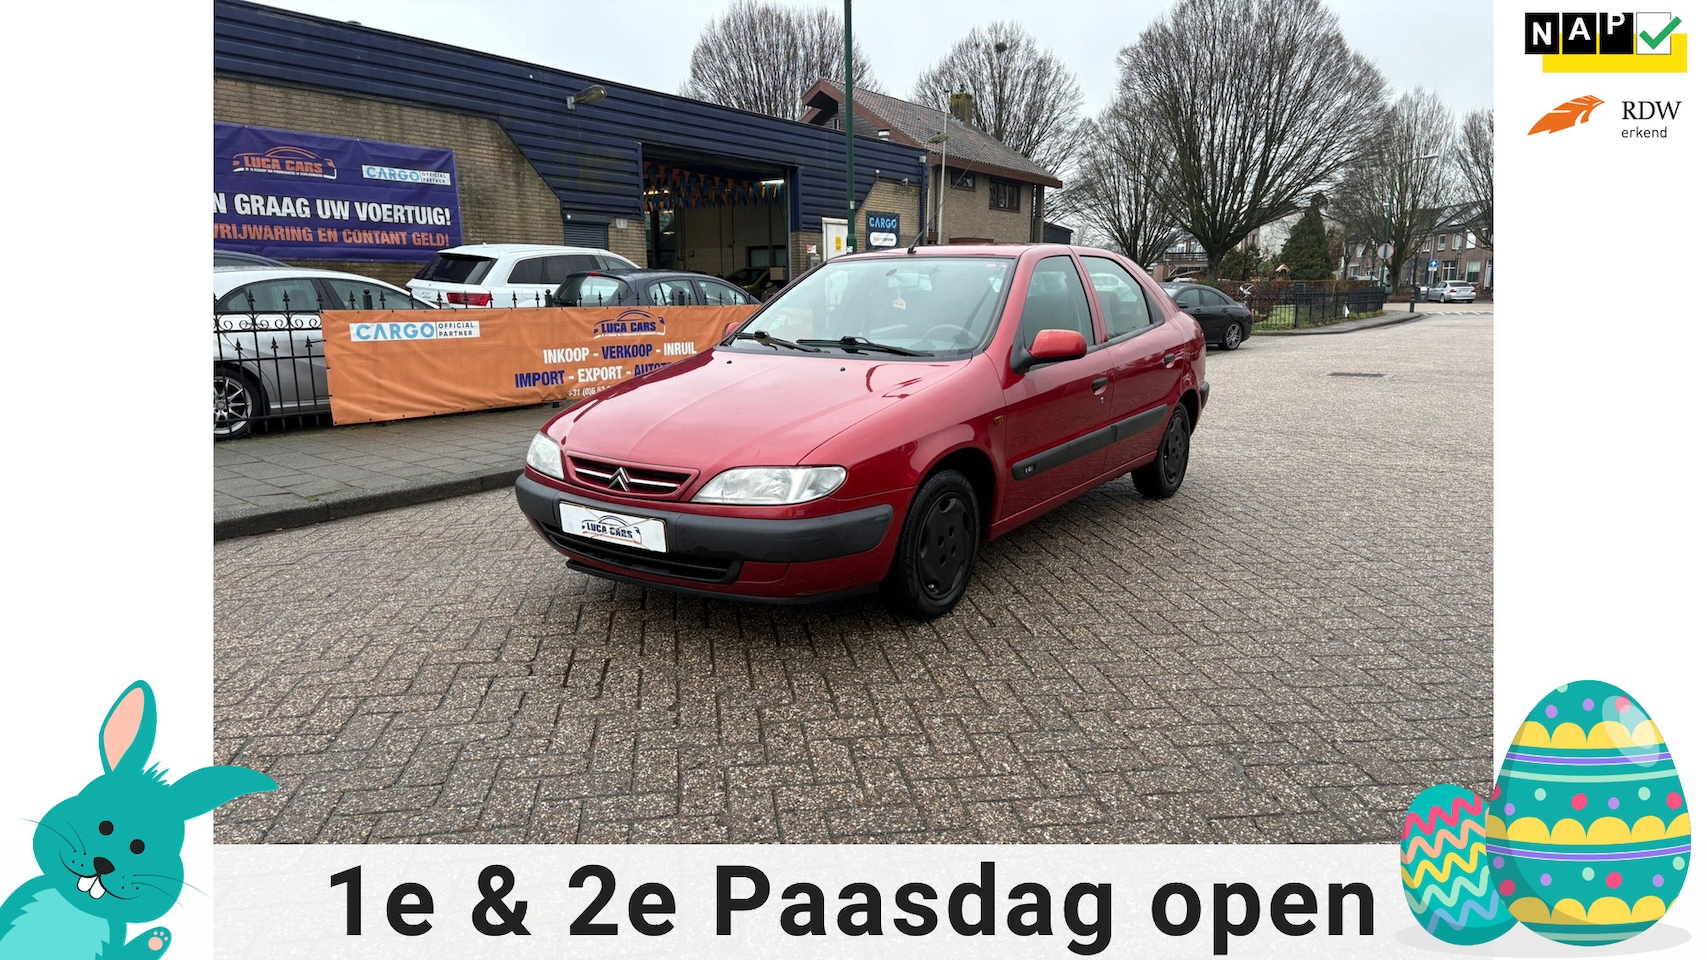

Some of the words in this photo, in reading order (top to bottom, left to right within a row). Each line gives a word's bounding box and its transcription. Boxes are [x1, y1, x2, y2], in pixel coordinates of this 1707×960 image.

[243, 155, 281, 170] LUCA
[285, 159, 323, 174] CARS
[366, 166, 420, 182] CARGO
[234, 193, 311, 218] GRAAG
[316, 198, 350, 221] UW
[353, 202, 451, 226] VOERTUIG!
[869, 216, 897, 230] CARGO
[317, 226, 338, 244] EN
[342, 229, 407, 246] CONTANT
[412, 232, 449, 247] GELD!
[356, 322, 435, 340] CARGO
[601, 322, 627, 333] LUCA
[630, 321, 657, 332] CARS
[543, 346, 590, 364] INKOOP
[601, 343, 653, 360] VERKOOP
[663, 341, 697, 357] INRUIL
[515, 369, 565, 388] IMPORT
[577, 365, 623, 383] EXPORT
[586, 522, 607, 533] LUCA
[609, 527, 633, 539] CARS
